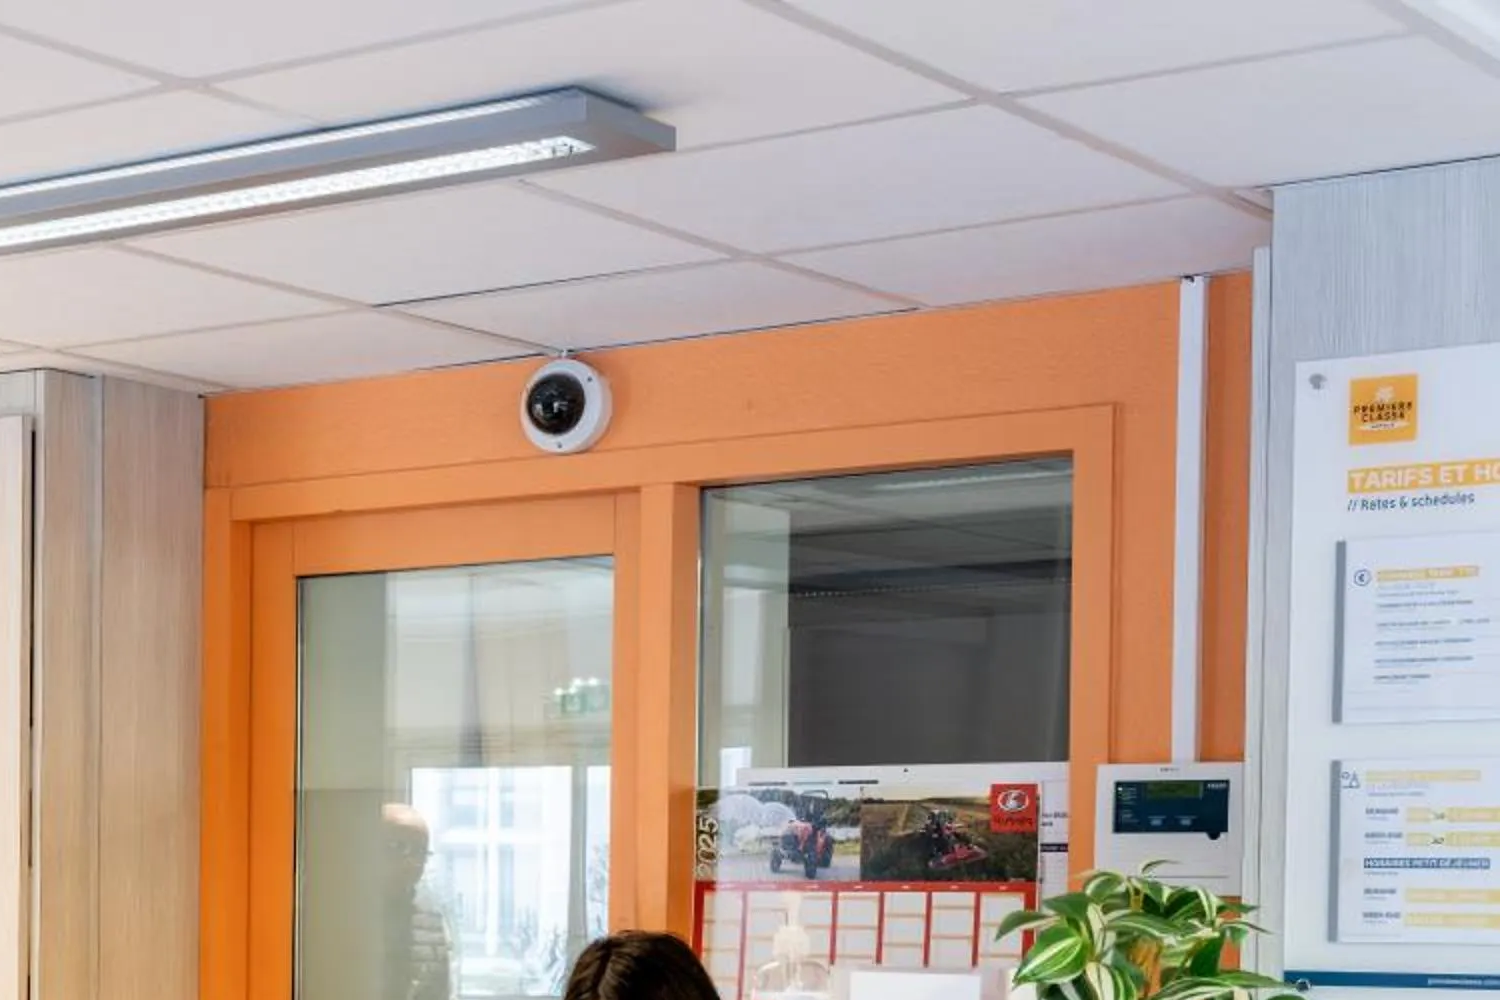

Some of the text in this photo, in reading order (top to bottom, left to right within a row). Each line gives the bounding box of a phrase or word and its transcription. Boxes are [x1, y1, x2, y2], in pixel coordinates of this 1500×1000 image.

[1350, 467, 1433, 490] TARIFS
[1440, 464, 1468, 484] ET
[1361, 498, 1397, 510] Rates
[1411, 492, 1475, 508] schedules
